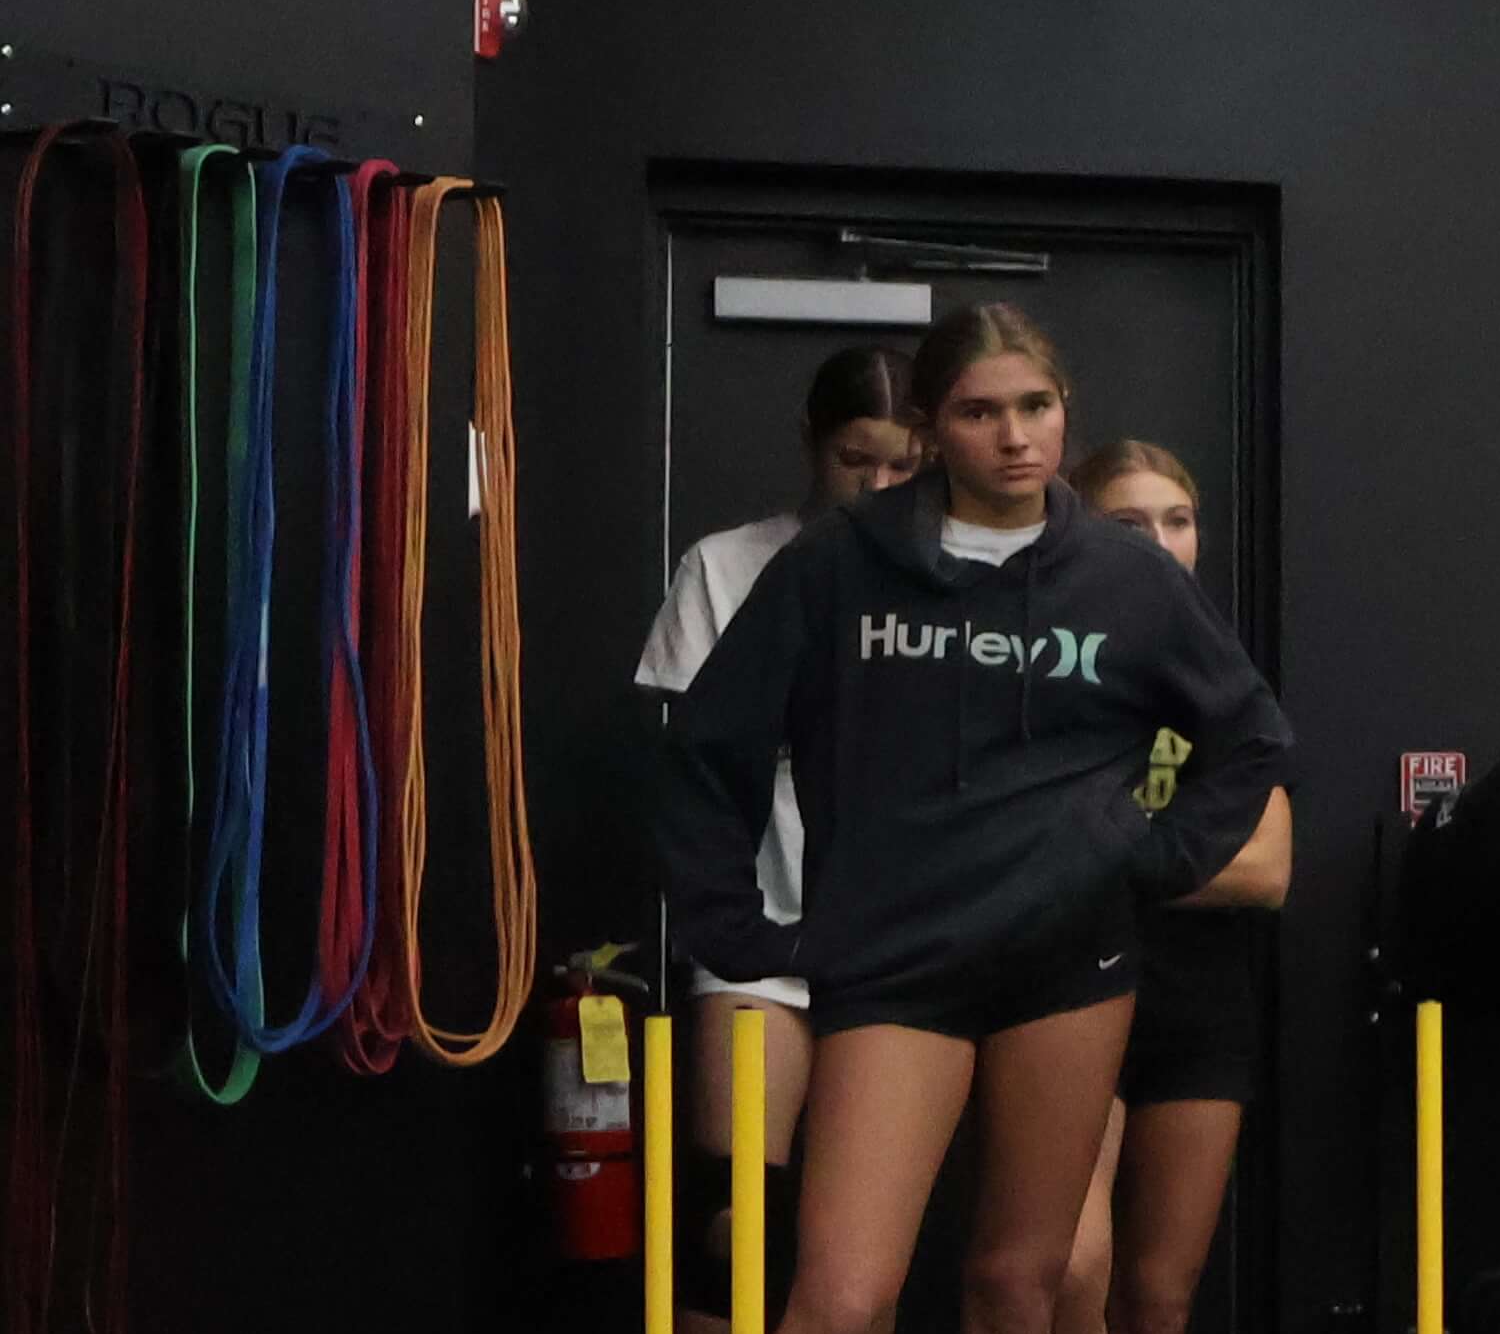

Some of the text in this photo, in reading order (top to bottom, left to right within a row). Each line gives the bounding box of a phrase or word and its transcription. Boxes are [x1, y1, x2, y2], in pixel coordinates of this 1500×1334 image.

[98, 78, 341, 148] ROGUE
[860, 613, 1048, 674] Hurley
[1409, 755, 1458, 778] FIRE
